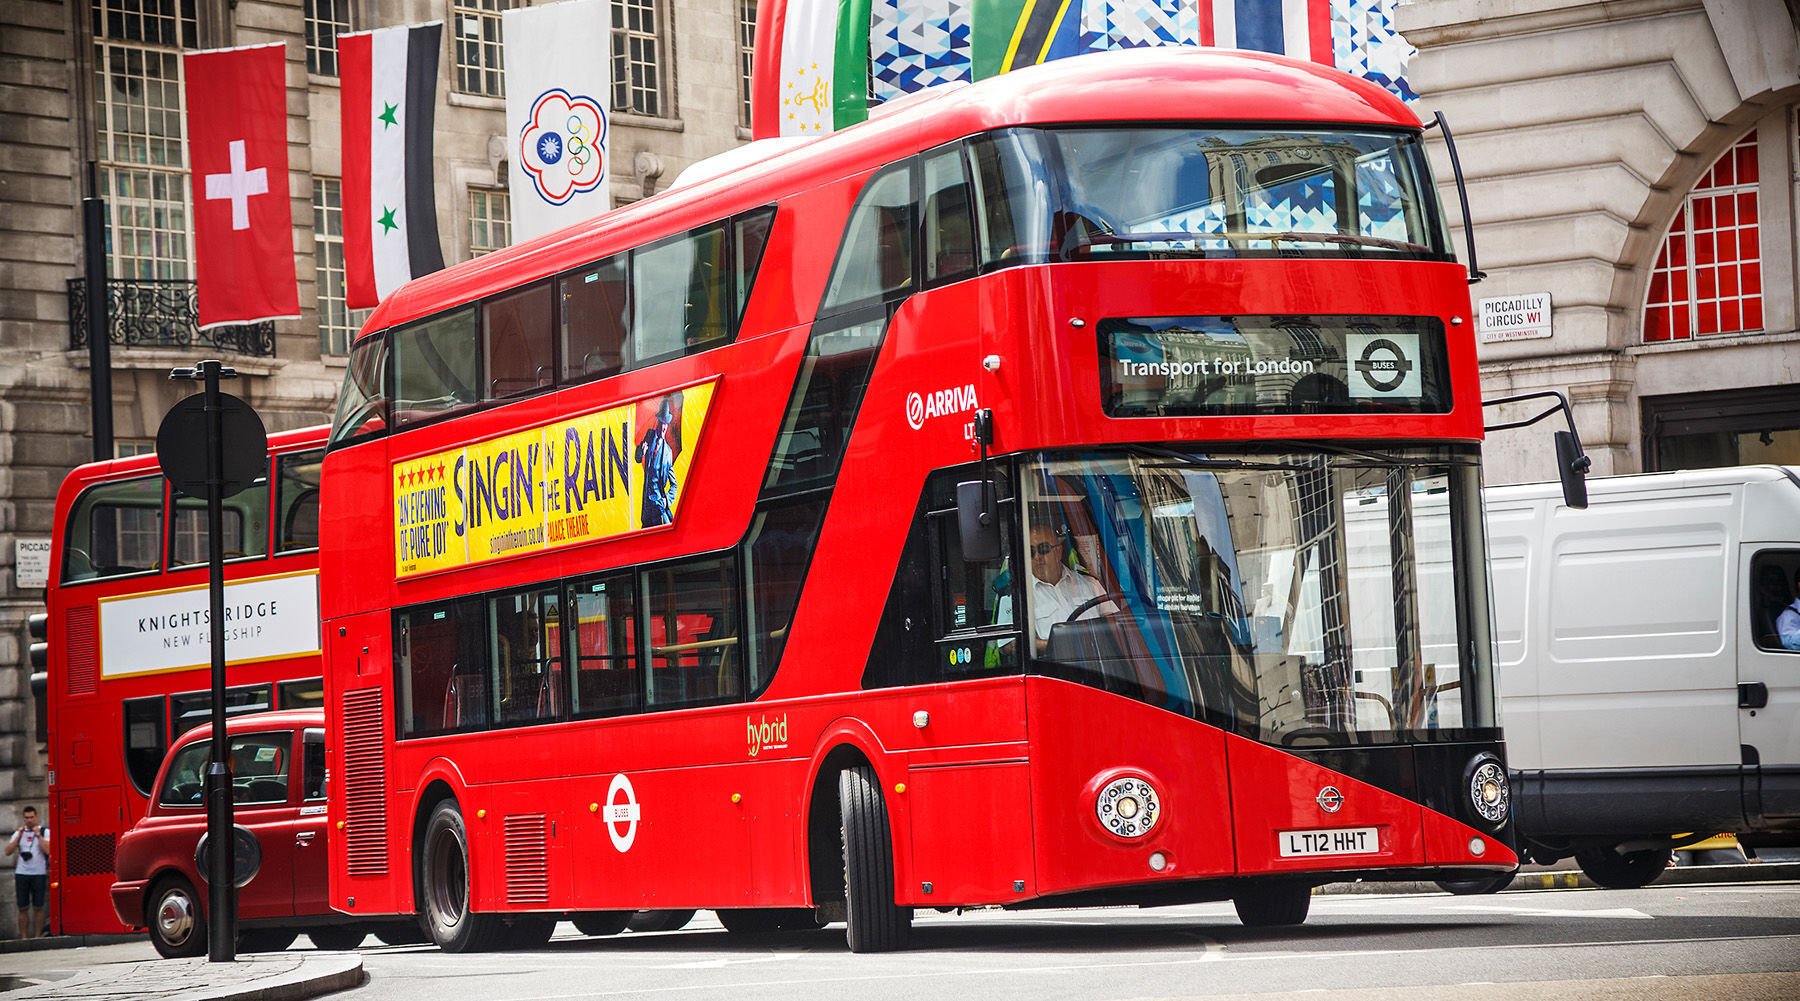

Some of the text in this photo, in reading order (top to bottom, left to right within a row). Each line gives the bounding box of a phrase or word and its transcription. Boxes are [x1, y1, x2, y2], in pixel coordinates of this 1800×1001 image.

[1485, 298, 1543, 313] PICCADILLY
[1486, 312, 1541, 327] CIRCUS W1
[1120, 357, 1314, 379] Transport for London
[925, 384, 978, 419] ARRIVA
[964, 422, 976, 440] LT
[454, 442, 540, 537] SINGIN'
[539, 479, 560, 512] THE
[565, 422, 630, 514] RAIN
[411, 486, 446, 524] EVENING
[566, 514, 590, 539] THEATRE
[20, 543, 50, 551] PICCAD
[400, 529, 408, 562] OF
[410, 524, 431, 560] PURE
[139, 601, 277, 632] KNIGHTSRIDGE
[163, 626, 262, 648] NEW FLGSHIP
[747, 712, 787, 756] hybrid
[1290, 832, 1367, 853] LT12 HHT
